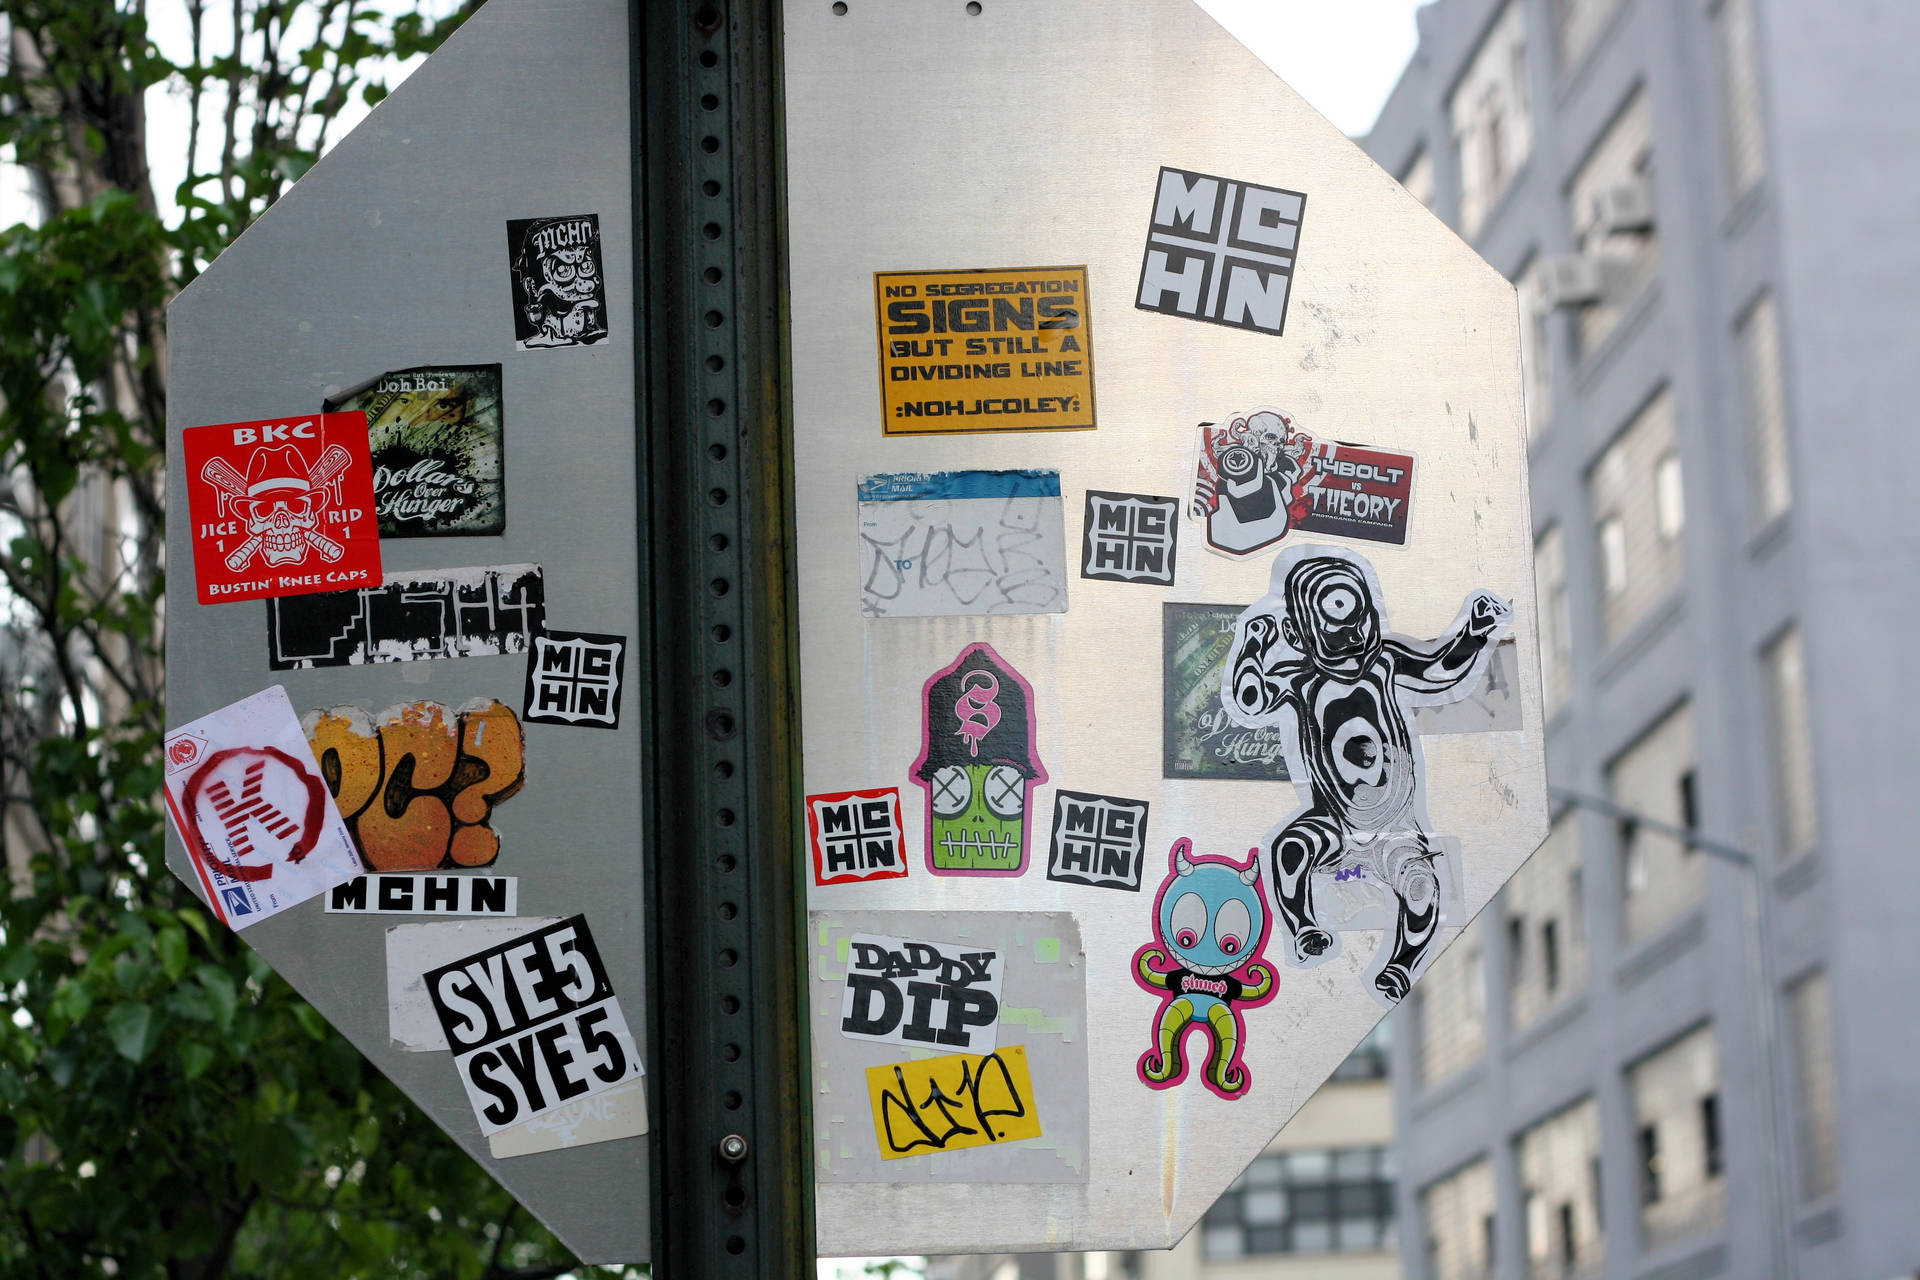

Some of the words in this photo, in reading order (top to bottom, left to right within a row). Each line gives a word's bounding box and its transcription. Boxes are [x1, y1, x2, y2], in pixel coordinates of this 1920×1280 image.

[886, 285, 917, 298] NO
[925, 280, 1079, 296] SEGREGATION
[887, 296, 1080, 334] SIGNS
[890, 339, 953, 357] BUT
[966, 336, 1048, 355] STILL
[1059, 335, 1081, 352] A
[890, 363, 1011, 381] DIVIDING
[1021, 360, 1082, 378] LINE
[233, 421, 316, 446] BKC
[1312, 457, 1404, 484] 14BOLT
[413, 482, 447, 498] Over
[376, 489, 464, 520] Hunger
[1308, 486, 1402, 522] THEORY
[328, 508, 363, 524] RID
[200, 521, 238, 539] JICE
[343, 526, 351, 539] 1
[216, 540, 225, 553] 1
[894, 560, 912, 570] TO
[332, 876, 507, 913] MCHN
[851, 942, 996, 989] DADDY
[842, 973, 998, 1047] DIP
